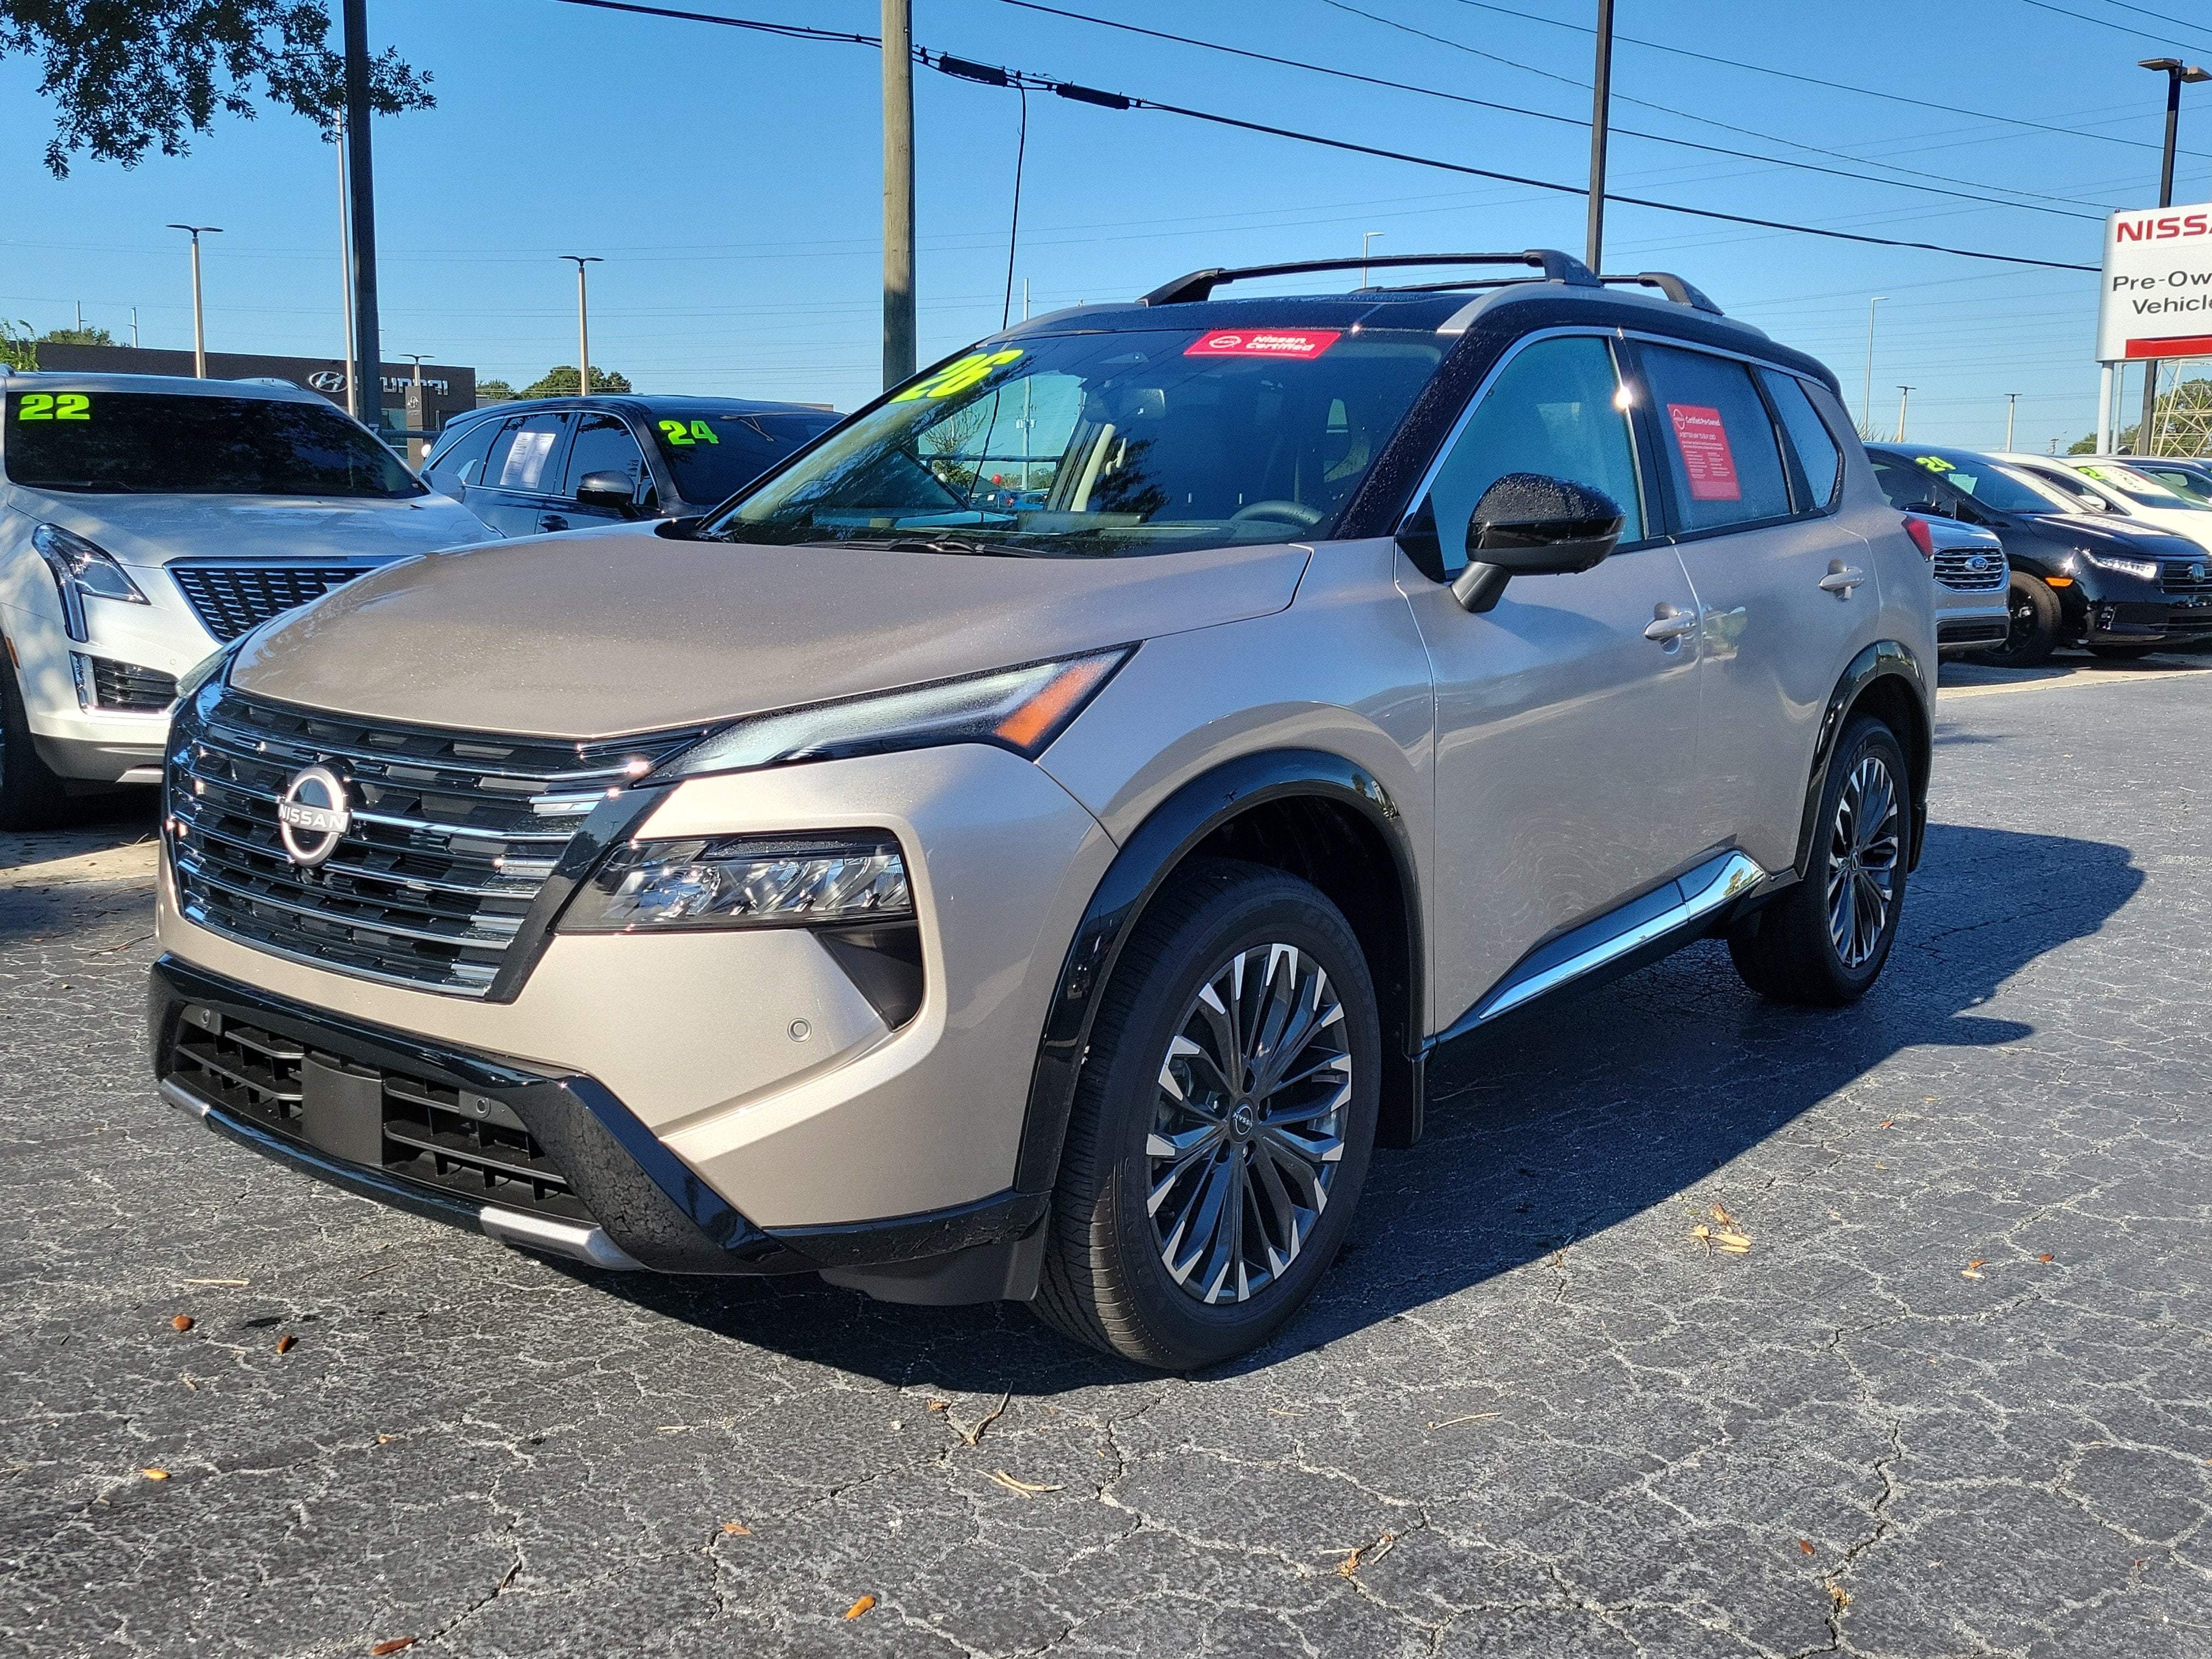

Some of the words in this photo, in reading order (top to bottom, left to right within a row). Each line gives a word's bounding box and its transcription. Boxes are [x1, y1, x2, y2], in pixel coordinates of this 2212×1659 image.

[2117, 214, 2212, 242] NISS
[2132, 295, 2212, 314] Vehicl
[1245, 342, 1315, 351] Certified
[19, 394, 91, 420] 22
[658, 420, 719, 445] 24
[1915, 456, 1956, 472] 24
[278, 803, 345, 830] NISSAN
